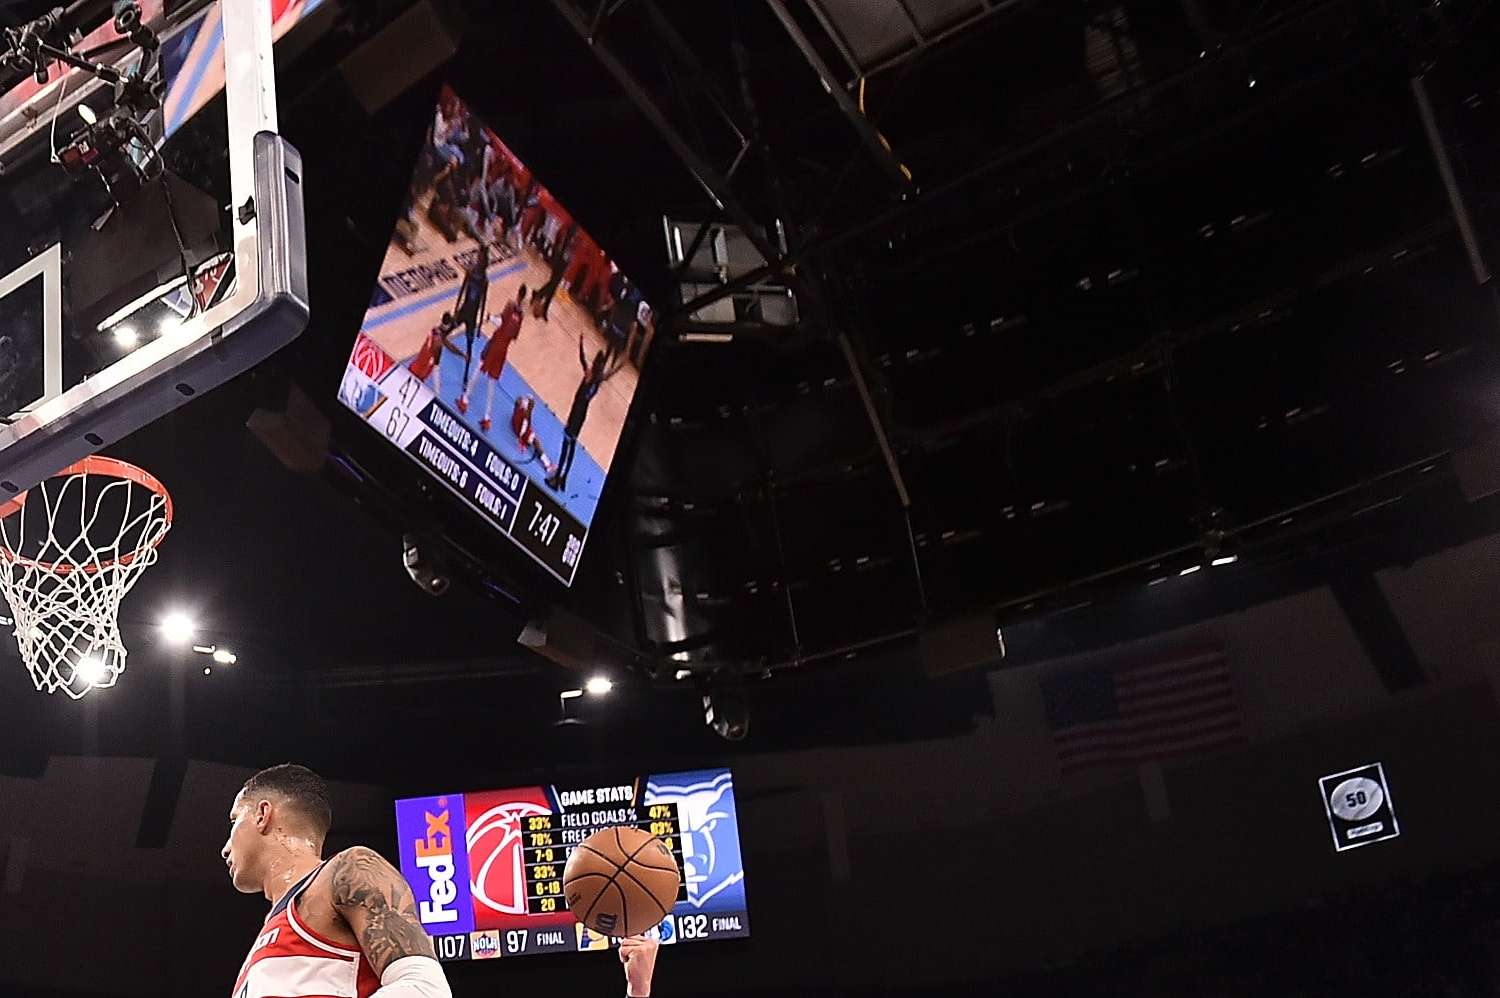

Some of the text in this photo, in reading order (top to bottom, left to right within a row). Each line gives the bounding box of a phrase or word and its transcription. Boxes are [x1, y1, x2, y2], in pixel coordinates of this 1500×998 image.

[399, 375, 421, 409] 47
[386, 406, 410, 443] 67
[528, 501, 560, 547] 7:47
[561, 786, 633, 806] GAME STATS
[1345, 791, 1367, 807] 50
[561, 812, 590, 827] FIELD
[562, 829, 585, 843] FREE
[415, 809, 458, 924] FedEx
[541, 898, 555, 911] 20
[678, 915, 709, 939] 132
[712, 917, 742, 932] FINAL
[438, 935, 465, 959] 107
[506, 929, 528, 953] 97
[536, 931, 565, 946] FINAL
